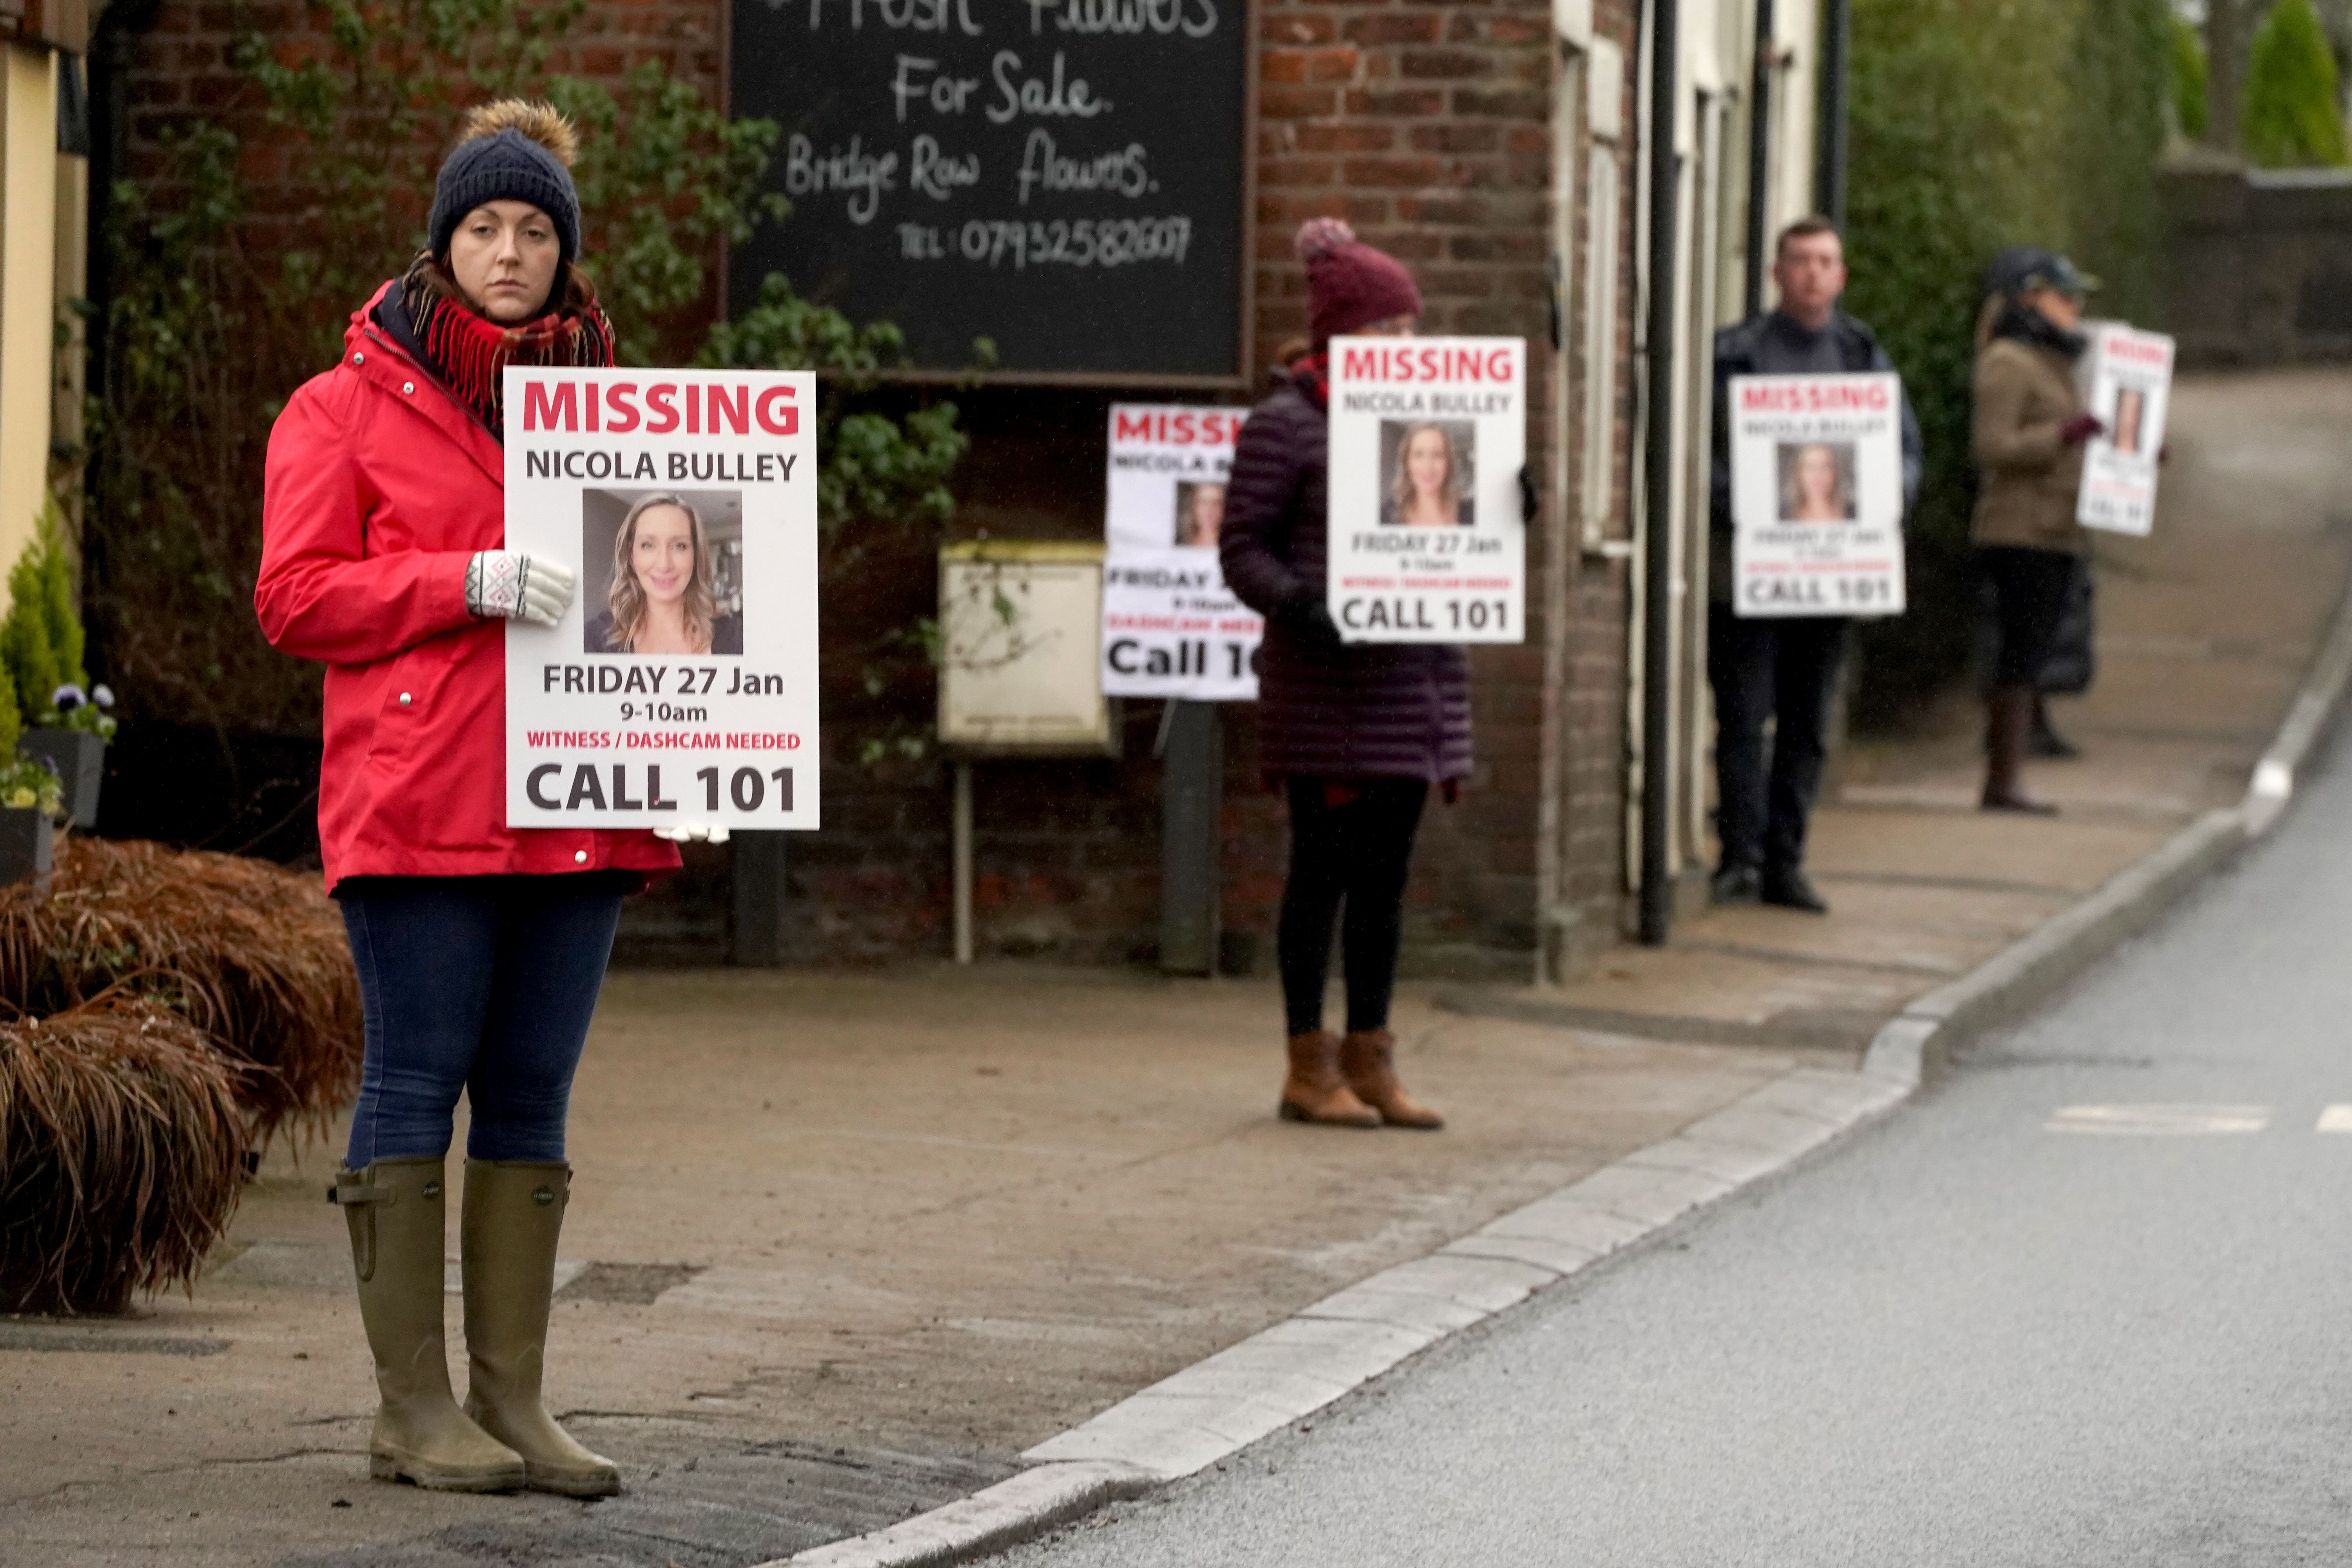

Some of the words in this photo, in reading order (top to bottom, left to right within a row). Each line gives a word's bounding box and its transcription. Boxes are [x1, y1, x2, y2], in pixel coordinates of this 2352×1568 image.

[889, 53, 980, 123] For
[786, 132, 899, 225] Bridge
[1343, 348, 1512, 382] MISSING
[523, 382, 798, 436] MISSING
[1344, 393, 1425, 413] NICOLA
[1430, 393, 1511, 414] BULLEY
[1742, 384, 1888, 411] MISSING
[527, 450, 656, 479] NICOLA
[668, 453, 797, 481] BULLEY
[1352, 533, 1429, 552] FRIDAY
[1744, 577, 1824, 604] CALL
[1836, 577, 1890, 603] 101
[1342, 598, 1432, 630] CALL
[1448, 600, 1506, 630] 101
[1108, 637, 1207, 676] Call
[544, 665, 667, 693] FRIDAY
[678, 668, 717, 694] 27
[727, 667, 782, 695] Jan
[621, 702, 707, 721] 9-10am
[528, 731, 610, 748] WITNESS
[627, 733, 720, 748] DASHCAM
[726, 733, 800, 749] NEEDED
[526, 763, 677, 810] CALL
[697, 767, 793, 812] 101
